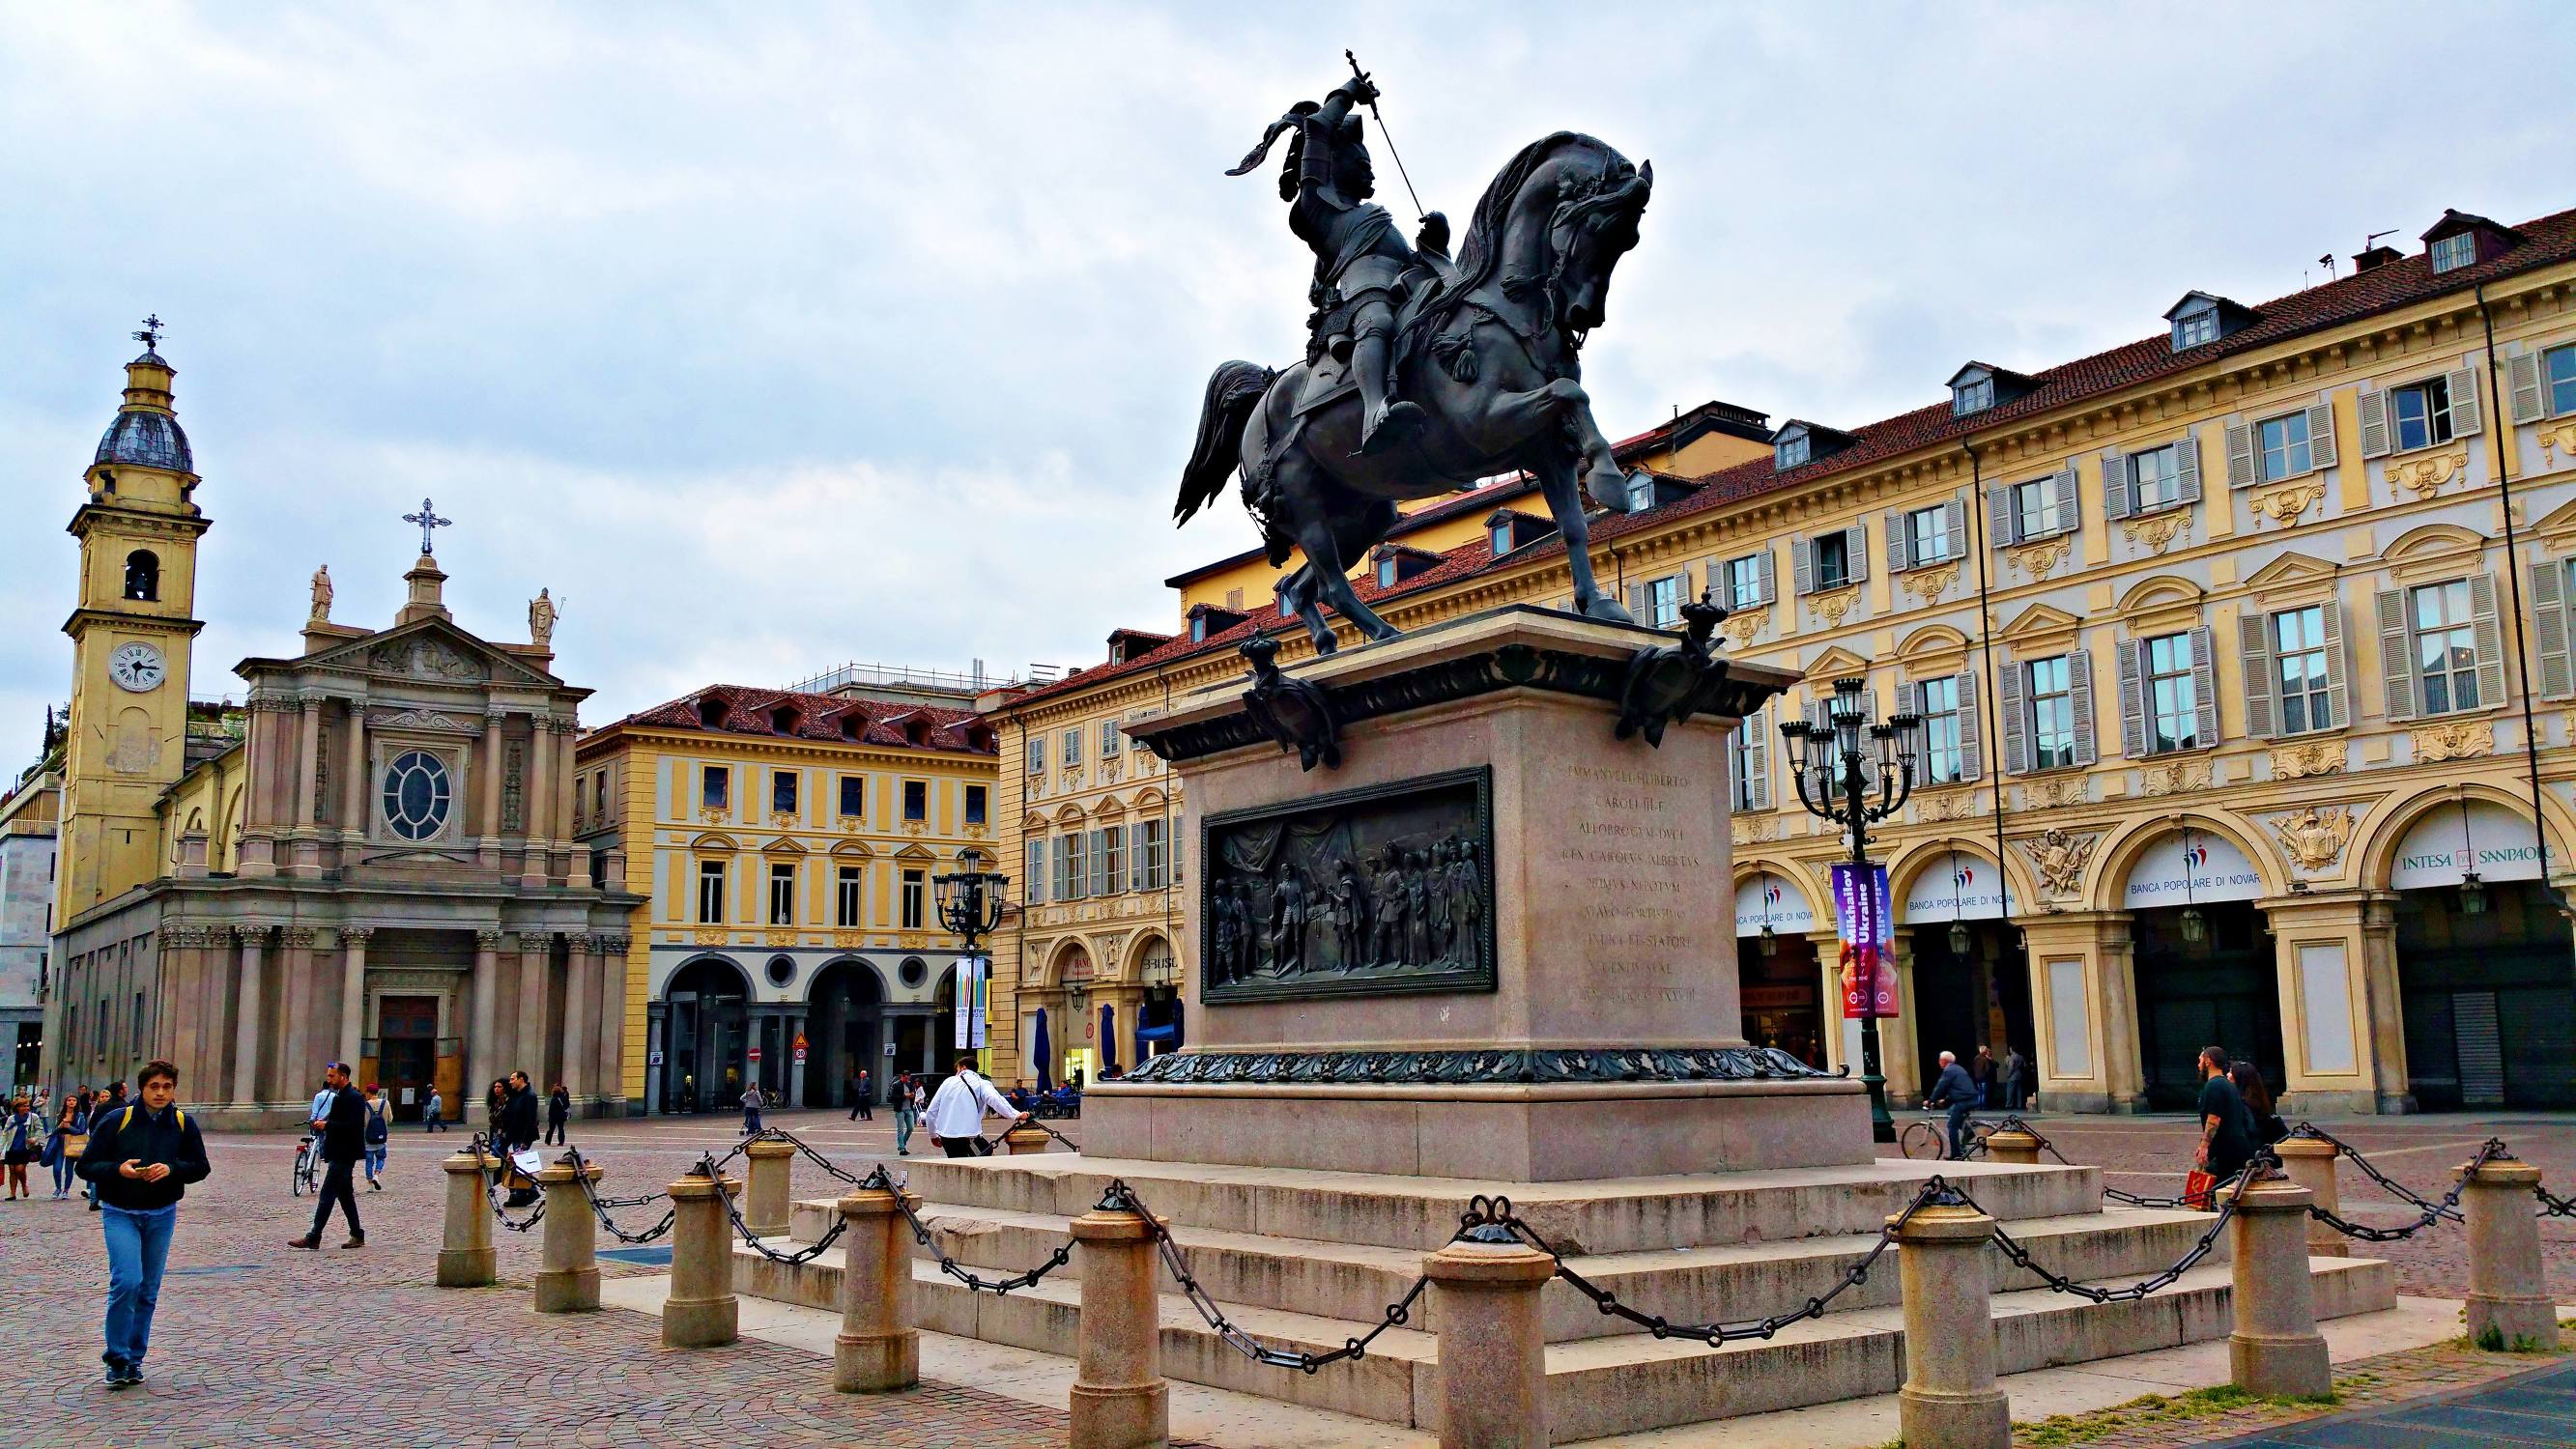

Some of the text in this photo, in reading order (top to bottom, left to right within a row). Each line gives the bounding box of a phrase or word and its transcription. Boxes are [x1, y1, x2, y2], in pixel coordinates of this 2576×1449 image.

[2401, 853, 2452, 870] INTESA
[2131, 882, 2160, 895] BANCA
[2216, 876, 2224, 887] DI
[1843, 869, 1857, 944] Mikhailov
[1909, 899, 1934, 911] BANCA
[1980, 895, 1989, 905] DI
[1786, 913, 1793, 922] DI
[1858, 883, 1870, 944] Ukraine
